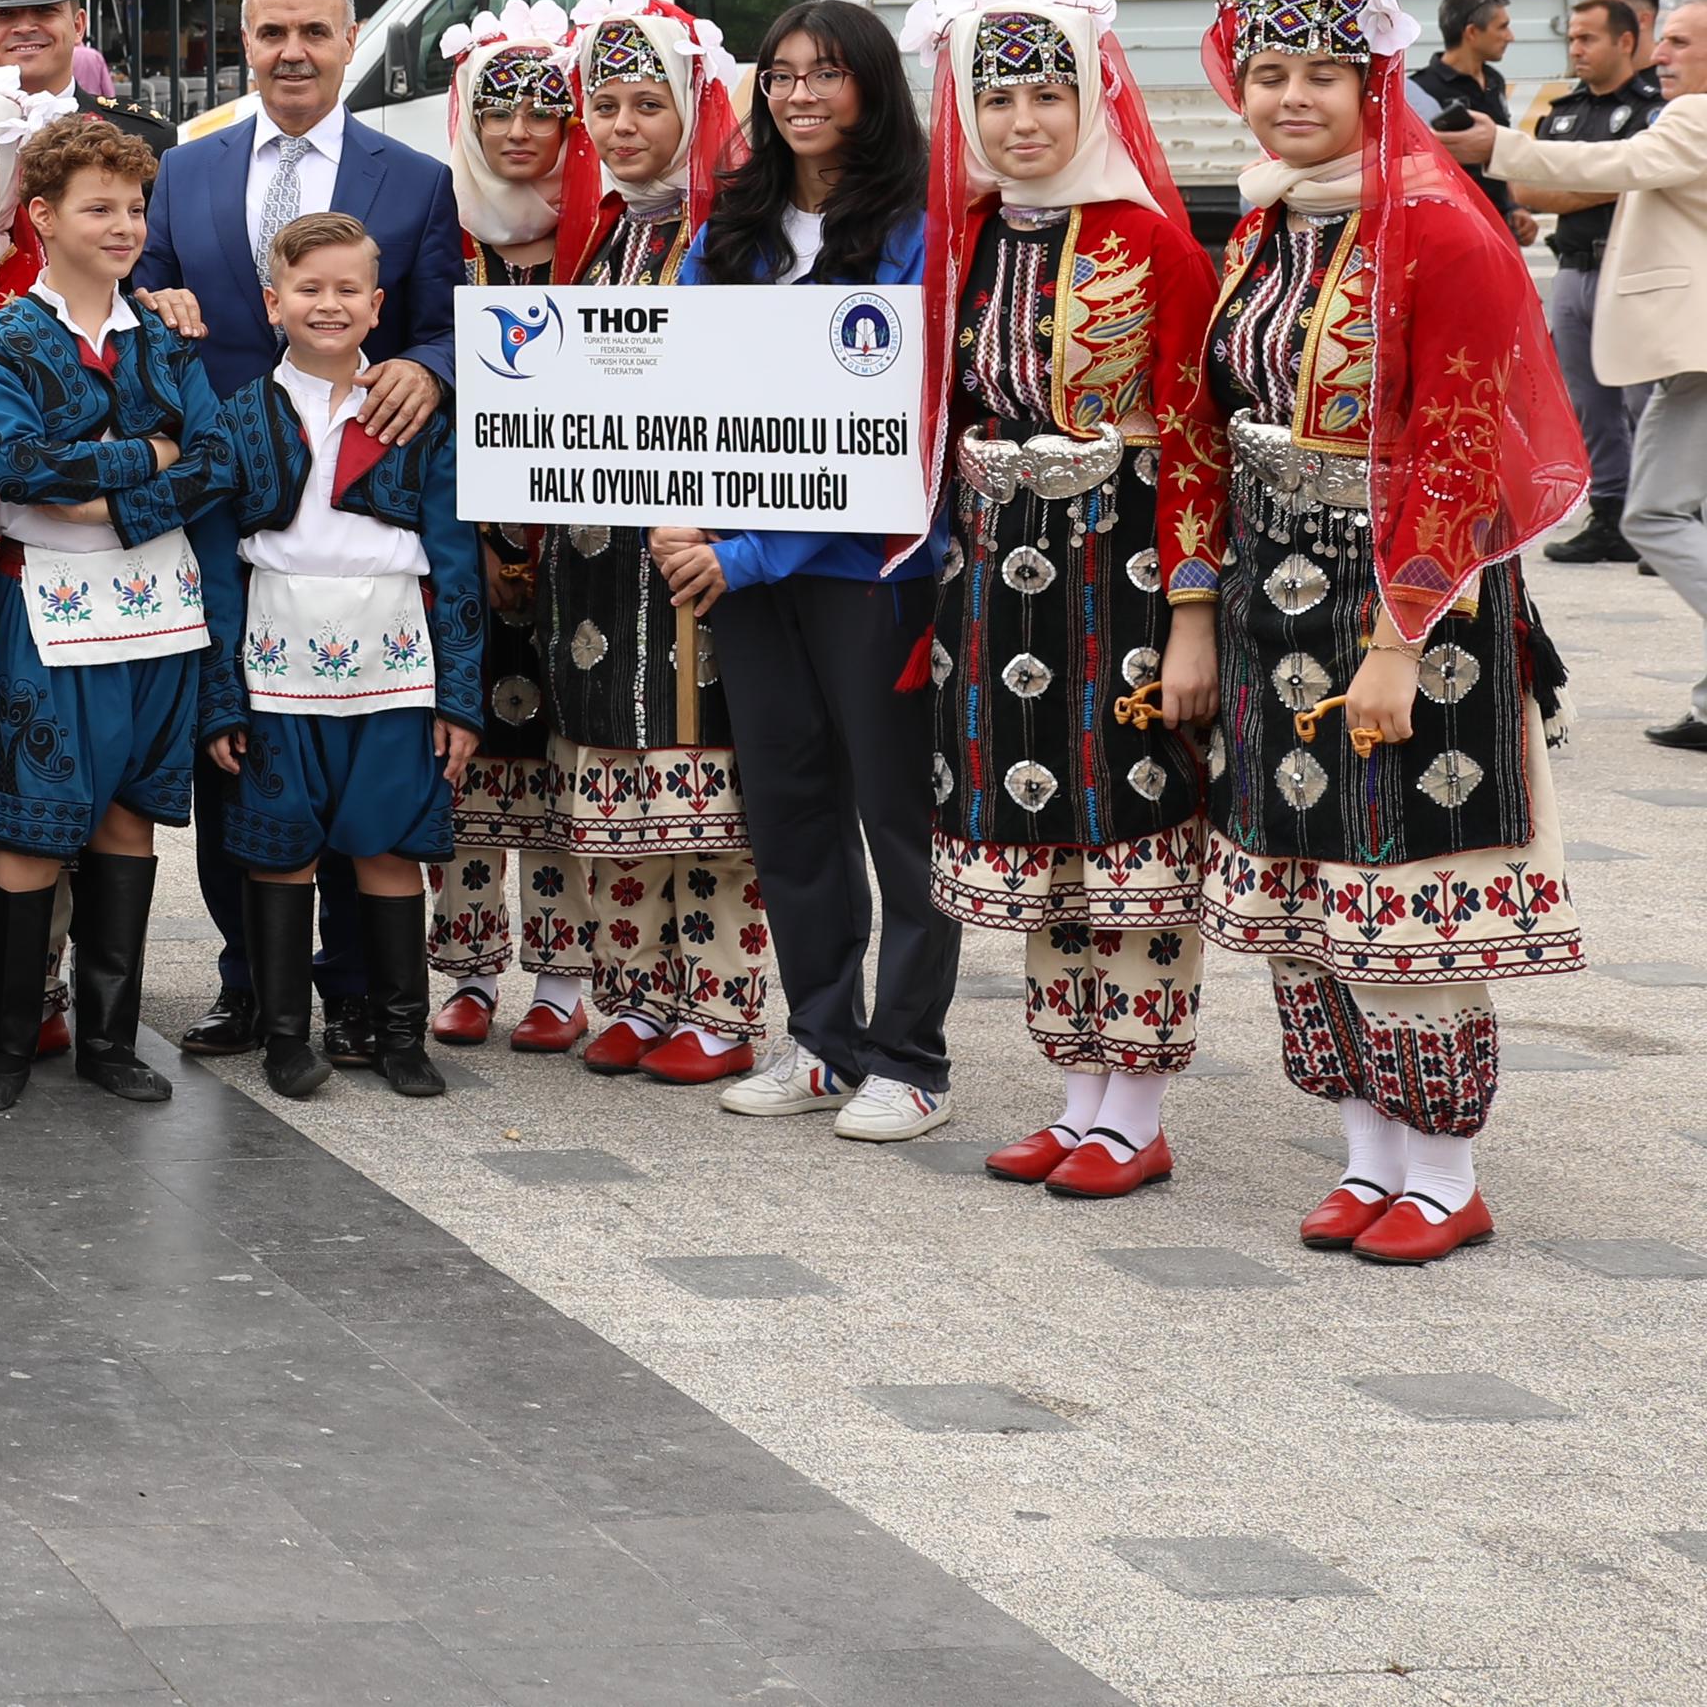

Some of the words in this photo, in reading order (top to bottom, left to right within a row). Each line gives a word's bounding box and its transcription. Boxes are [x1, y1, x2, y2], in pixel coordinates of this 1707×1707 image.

[578, 307, 669, 333] THOF
[612, 337, 629, 345] HALK
[630, 337, 664, 345] OYUNLARI
[600, 346, 647, 354] FEDERASYONU
[589, 358, 617, 366] TURKISH
[619, 358, 635, 366] FOLK
[636, 358, 658, 366] DANCE
[604, 367, 643, 375] FEDERATION
[475, 407, 555, 449] GEMLİK
[562, 414, 629, 450] CELAL
[637, 415, 708, 452] BAYAR
[715, 416, 827, 454] ANADOLU
[837, 411, 908, 455] LİSESİ
[530, 467, 585, 503] HALK
[592, 468, 704, 506] OYUNLARI
[712, 466, 848, 510] TOPLULUĞU
